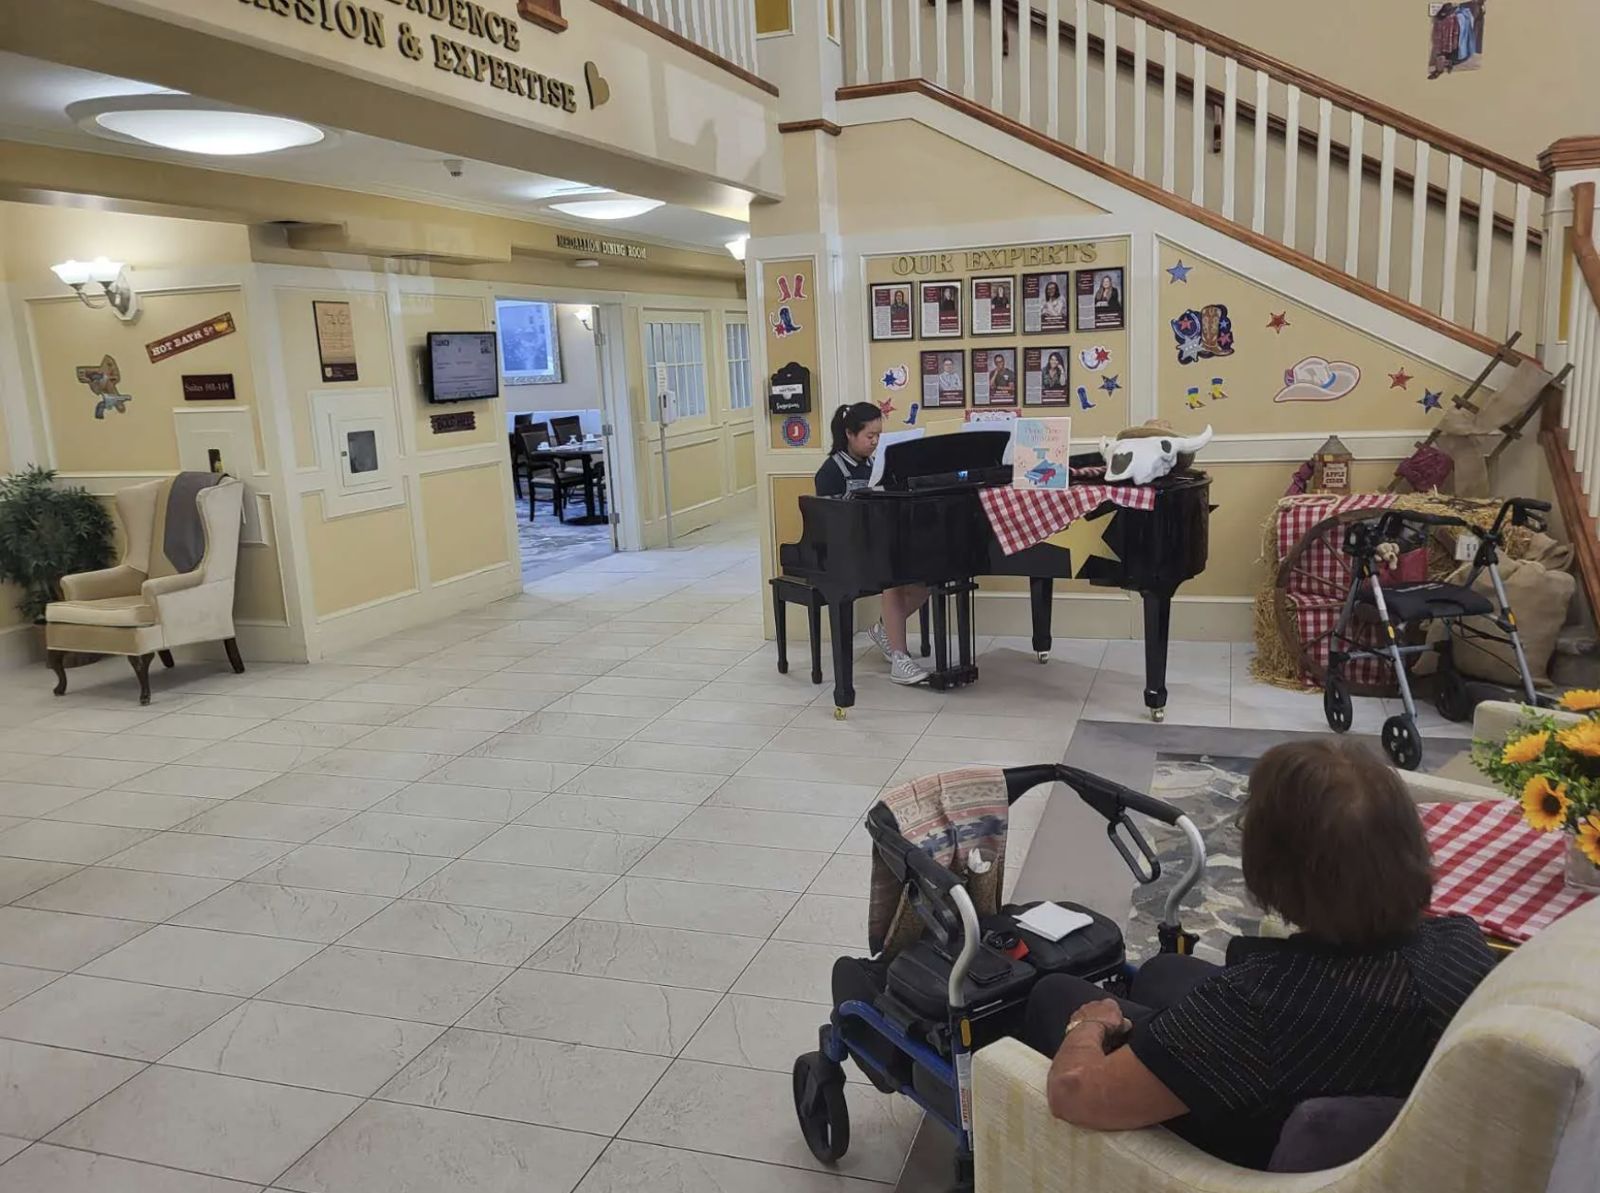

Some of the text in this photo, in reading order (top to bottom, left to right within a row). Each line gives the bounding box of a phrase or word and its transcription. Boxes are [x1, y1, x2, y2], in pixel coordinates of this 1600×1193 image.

[386, 0, 520, 52] DENCE
[398, 22, 423, 61] &
[431, 34, 577, 113] EXPERTISE
[601, 241, 626, 256] DINING
[892, 243, 1098, 276] OUR EXPERTS
[151, 342, 173, 356] HOT
[173, 330, 203, 347] BATH
